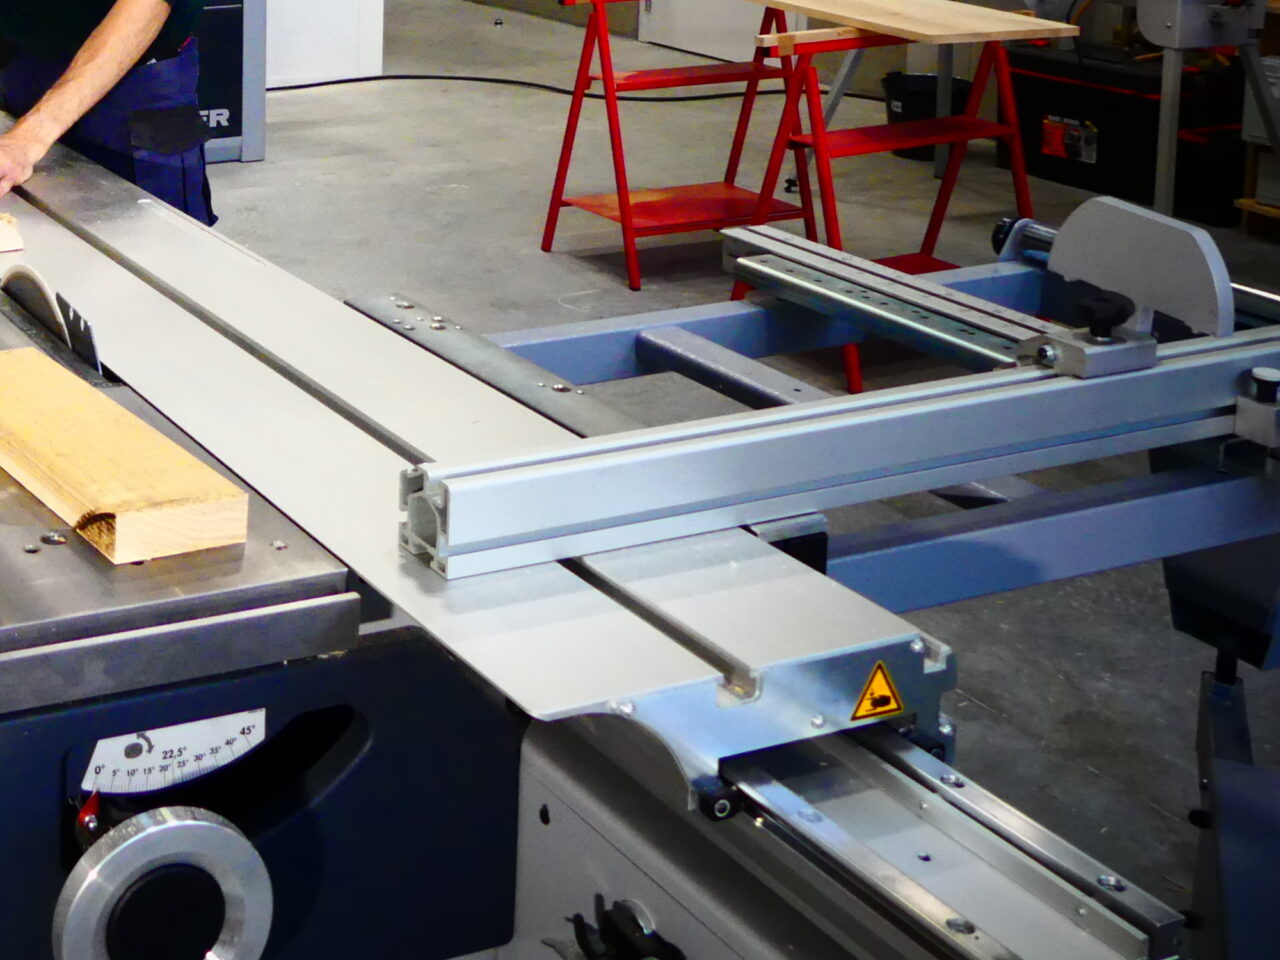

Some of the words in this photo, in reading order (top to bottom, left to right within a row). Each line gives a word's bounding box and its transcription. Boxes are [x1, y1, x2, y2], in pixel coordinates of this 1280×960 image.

[239, 724, 256, 736] 45°
[112, 768, 120, 777] 5°
[126, 768, 138, 777] 10°
[143, 766, 155, 775] 15°
[159, 763, 171, 772] 20°
[177, 759, 189, 768] 25°
[193, 752, 206, 762] 30°
[209, 746, 222, 755] 35°
[224, 737, 237, 747] 40°
[161, 746, 187, 760] 22,5°
[94, 764, 106, 775] 0°
